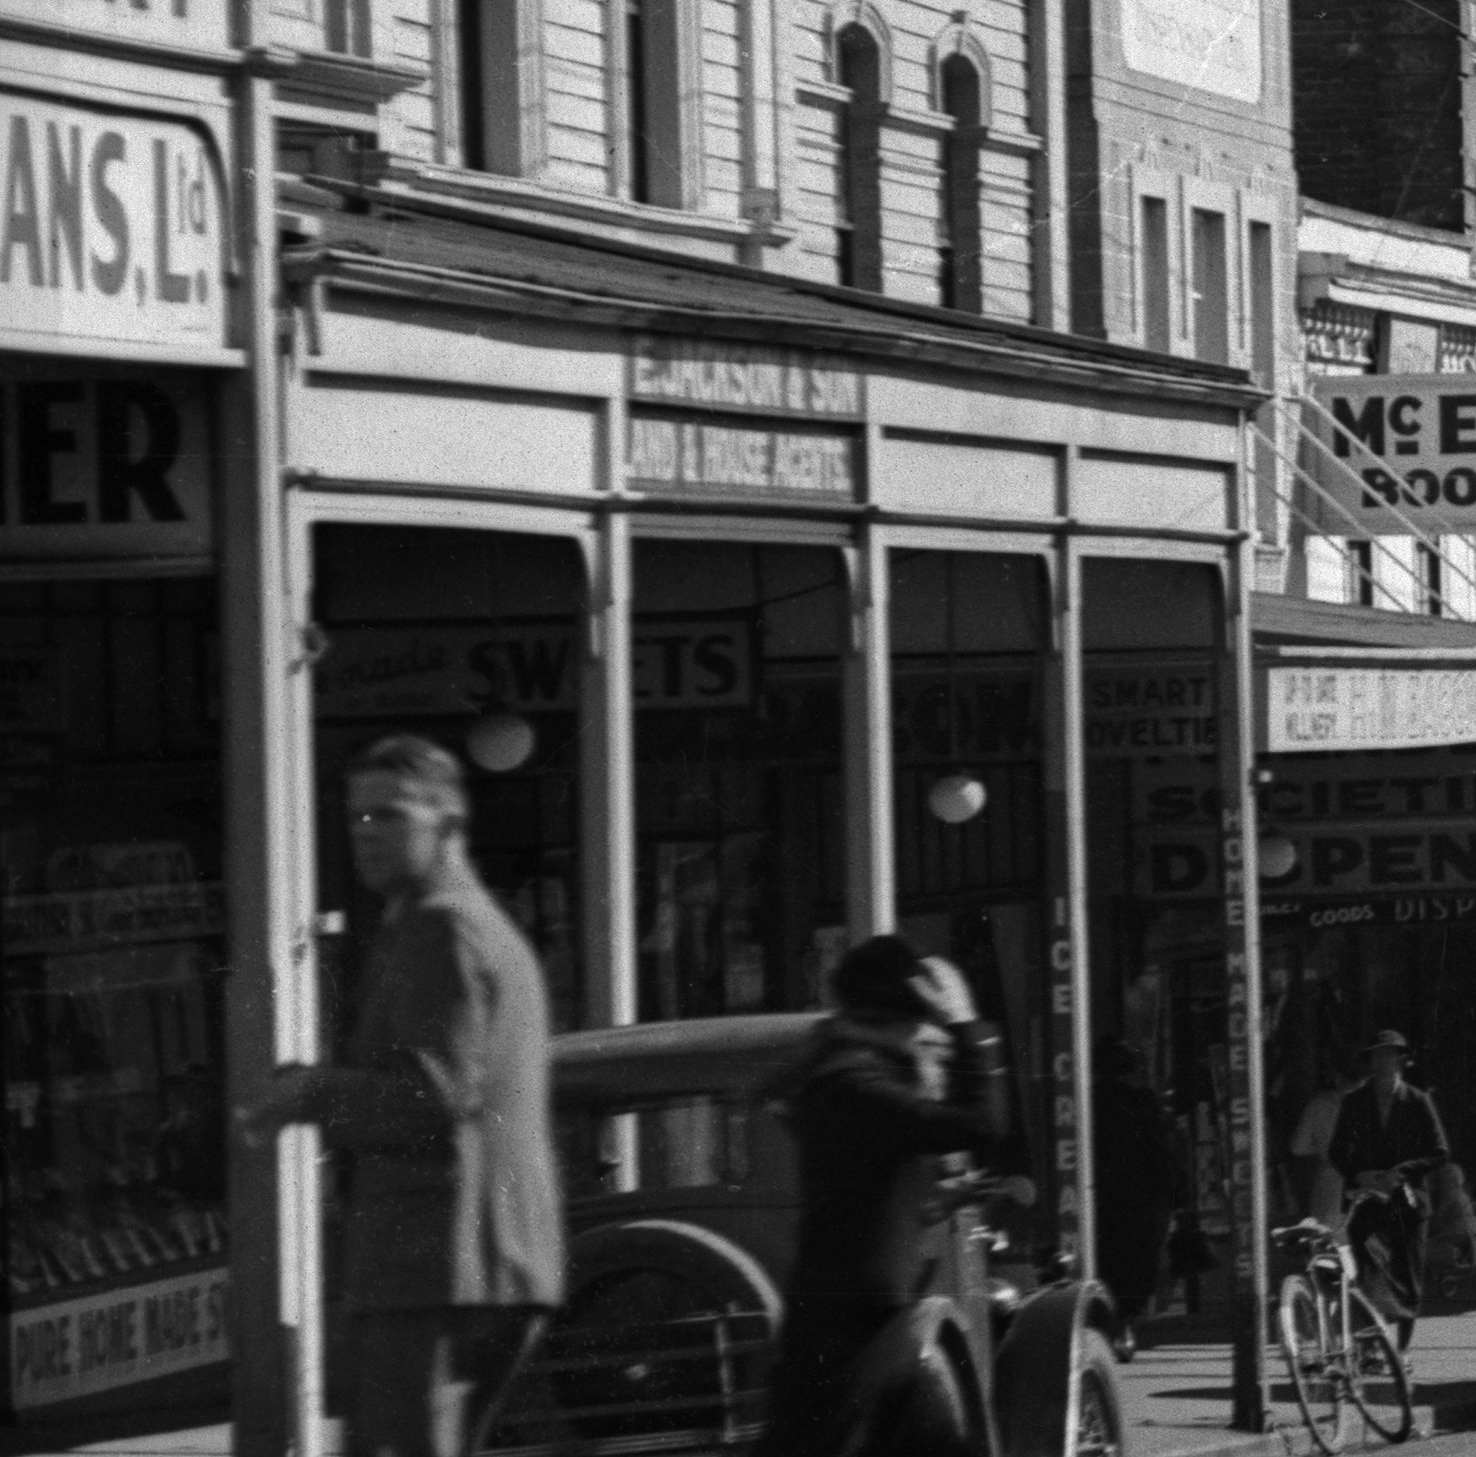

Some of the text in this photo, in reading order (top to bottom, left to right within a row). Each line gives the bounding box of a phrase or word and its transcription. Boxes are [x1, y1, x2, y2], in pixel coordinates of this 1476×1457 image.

[1091, 676, 1208, 708] SMART
[1309, 903, 1375, 928] GOODS
[1051, 897, 1073, 1014] ICE
[80, 1297, 138, 1375] HOME
